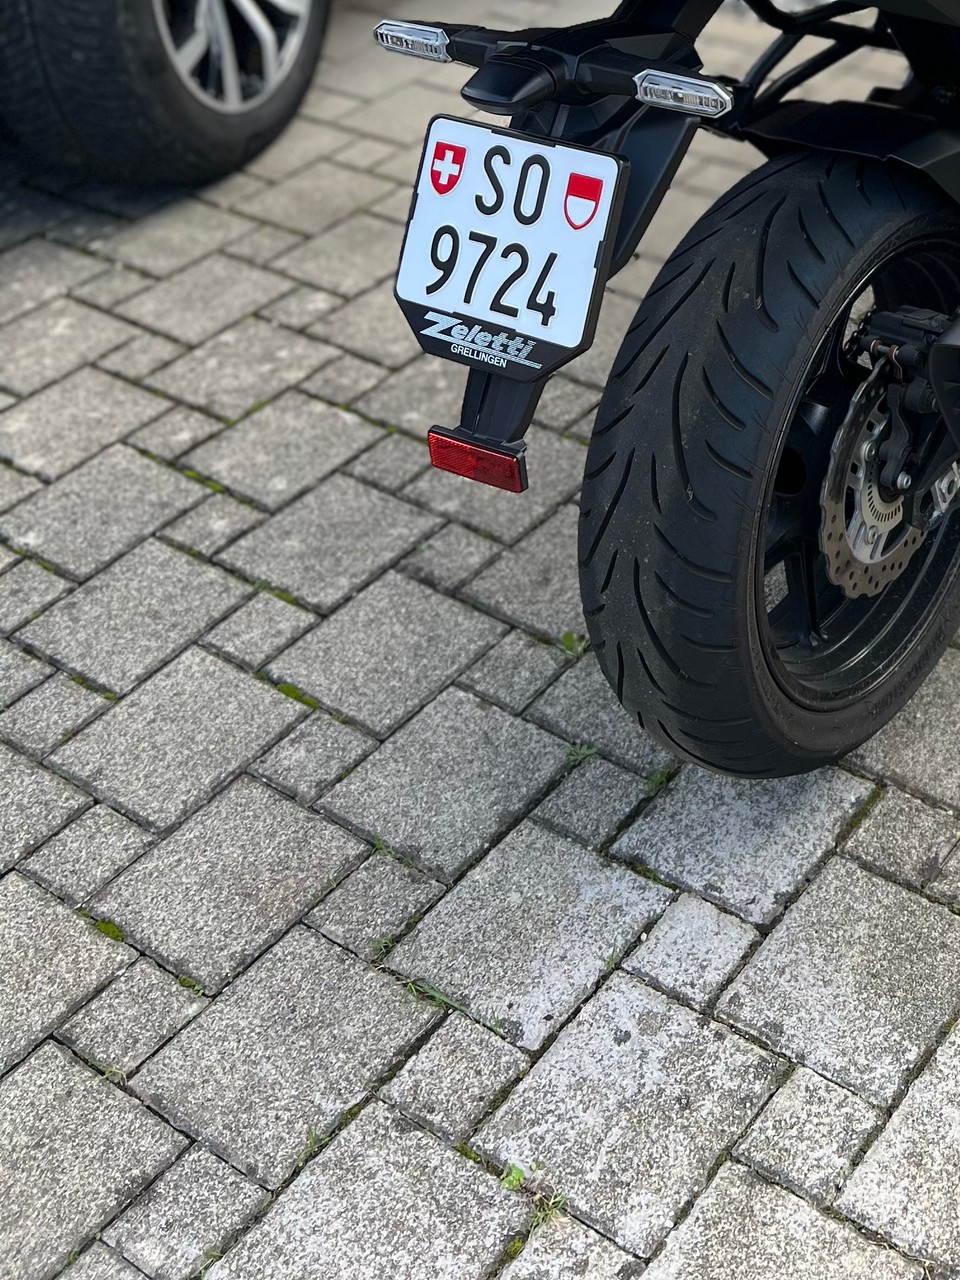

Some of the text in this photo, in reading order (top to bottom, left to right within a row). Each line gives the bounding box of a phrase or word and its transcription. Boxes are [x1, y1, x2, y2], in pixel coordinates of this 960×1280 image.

[475, 145, 550, 225] SO
[425, 224, 558, 326] 9724
[420, 311, 537, 360] Zeletti
[450, 343, 507, 368] GRELLINGEN
